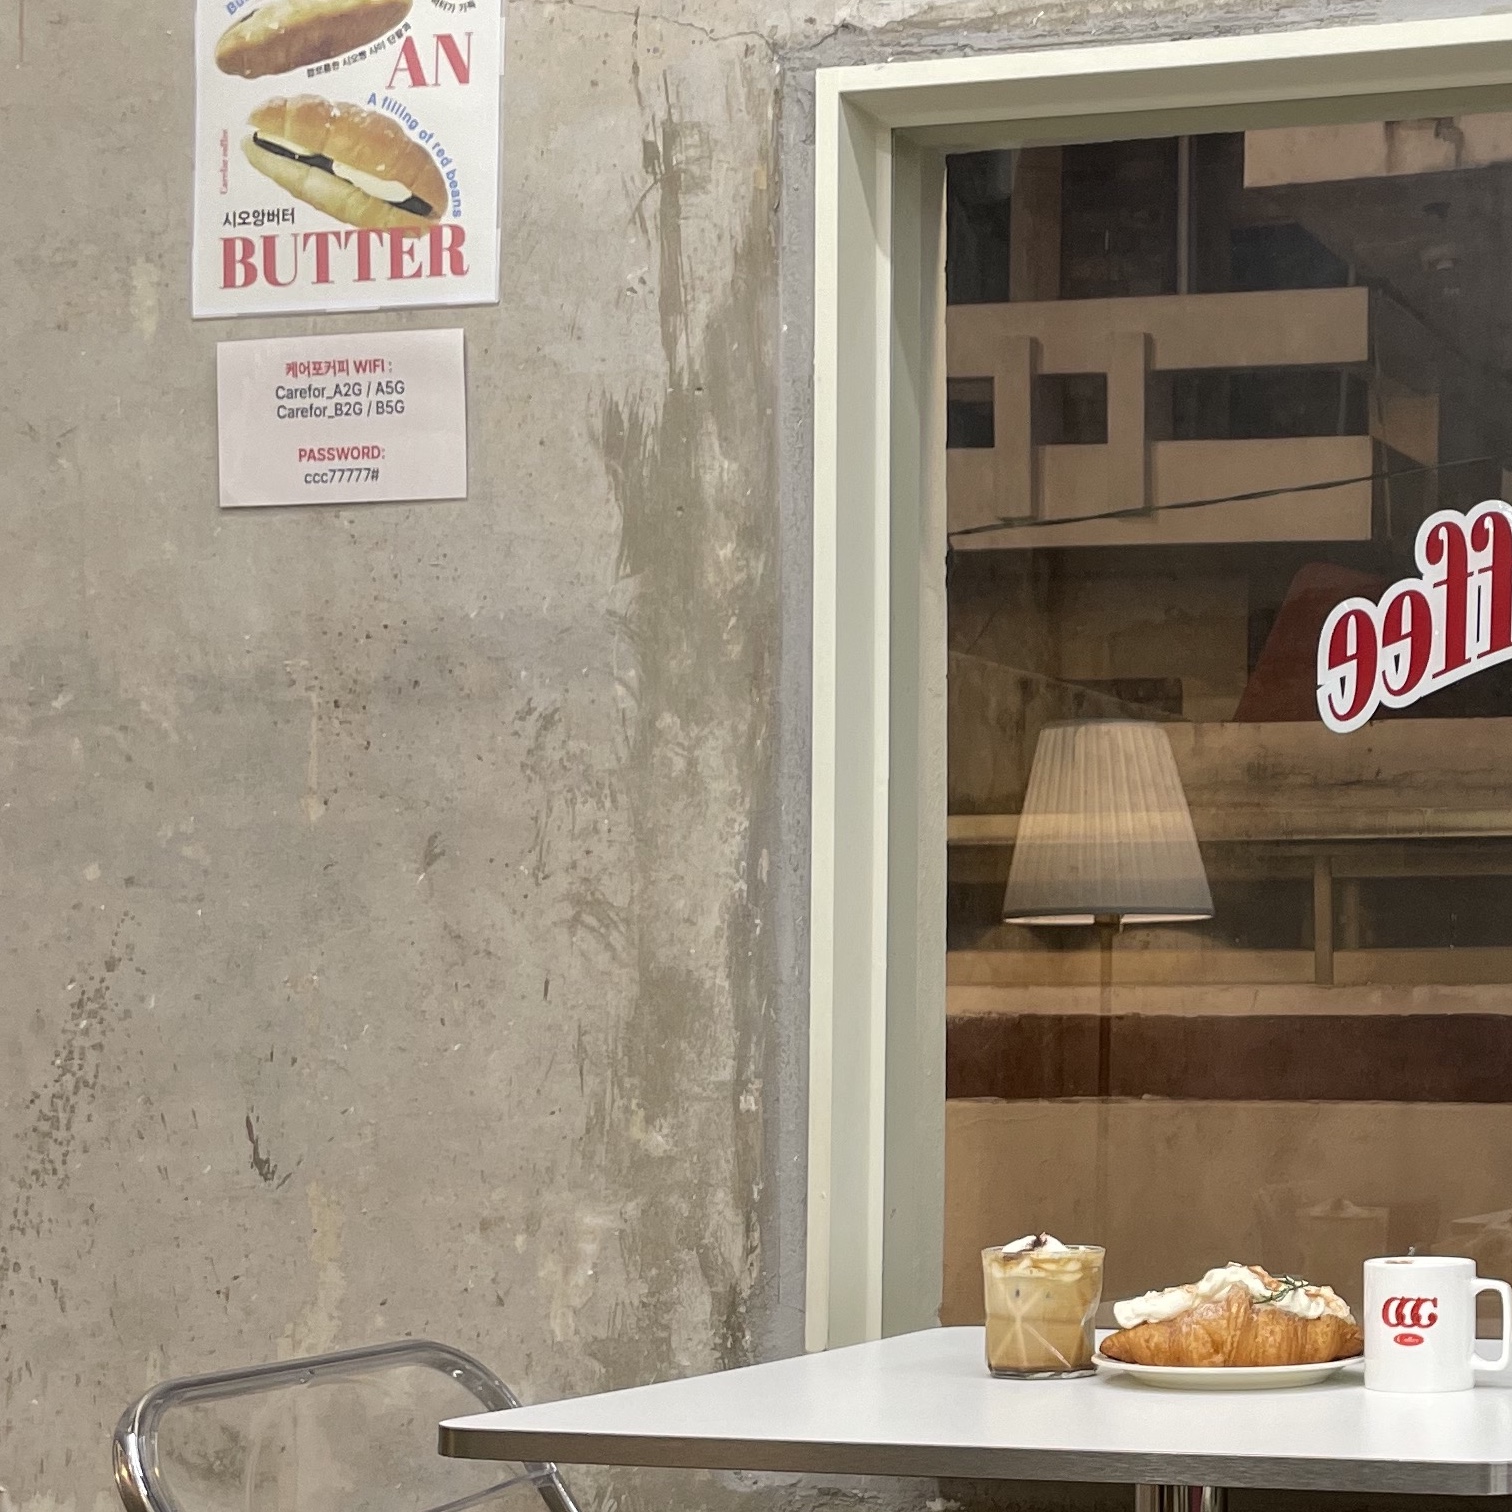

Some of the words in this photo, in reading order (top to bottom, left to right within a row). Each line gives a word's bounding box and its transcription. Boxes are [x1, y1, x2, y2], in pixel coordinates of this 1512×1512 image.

[385, 31, 474, 90] AN
[367, 92, 377, 106] A
[381, 96, 419, 130] filling
[418, 129, 434, 144] of
[432, 142, 453, 168] red
[446, 168, 462, 217] beans
[222, 207, 296, 229] 시오앙버터
[219, 223, 470, 290] BUTTER
[285, 359, 350, 379] 케어포커피
[275, 382, 362, 401] Carefor_A2G
[375, 379, 405, 396] A5G
[276, 401, 363, 420] Carefor_B2G
[375, 399, 405, 416] B5G
[298, 445, 386, 463] PASSWORD:
[304, 467, 380, 485] ccc77777#
